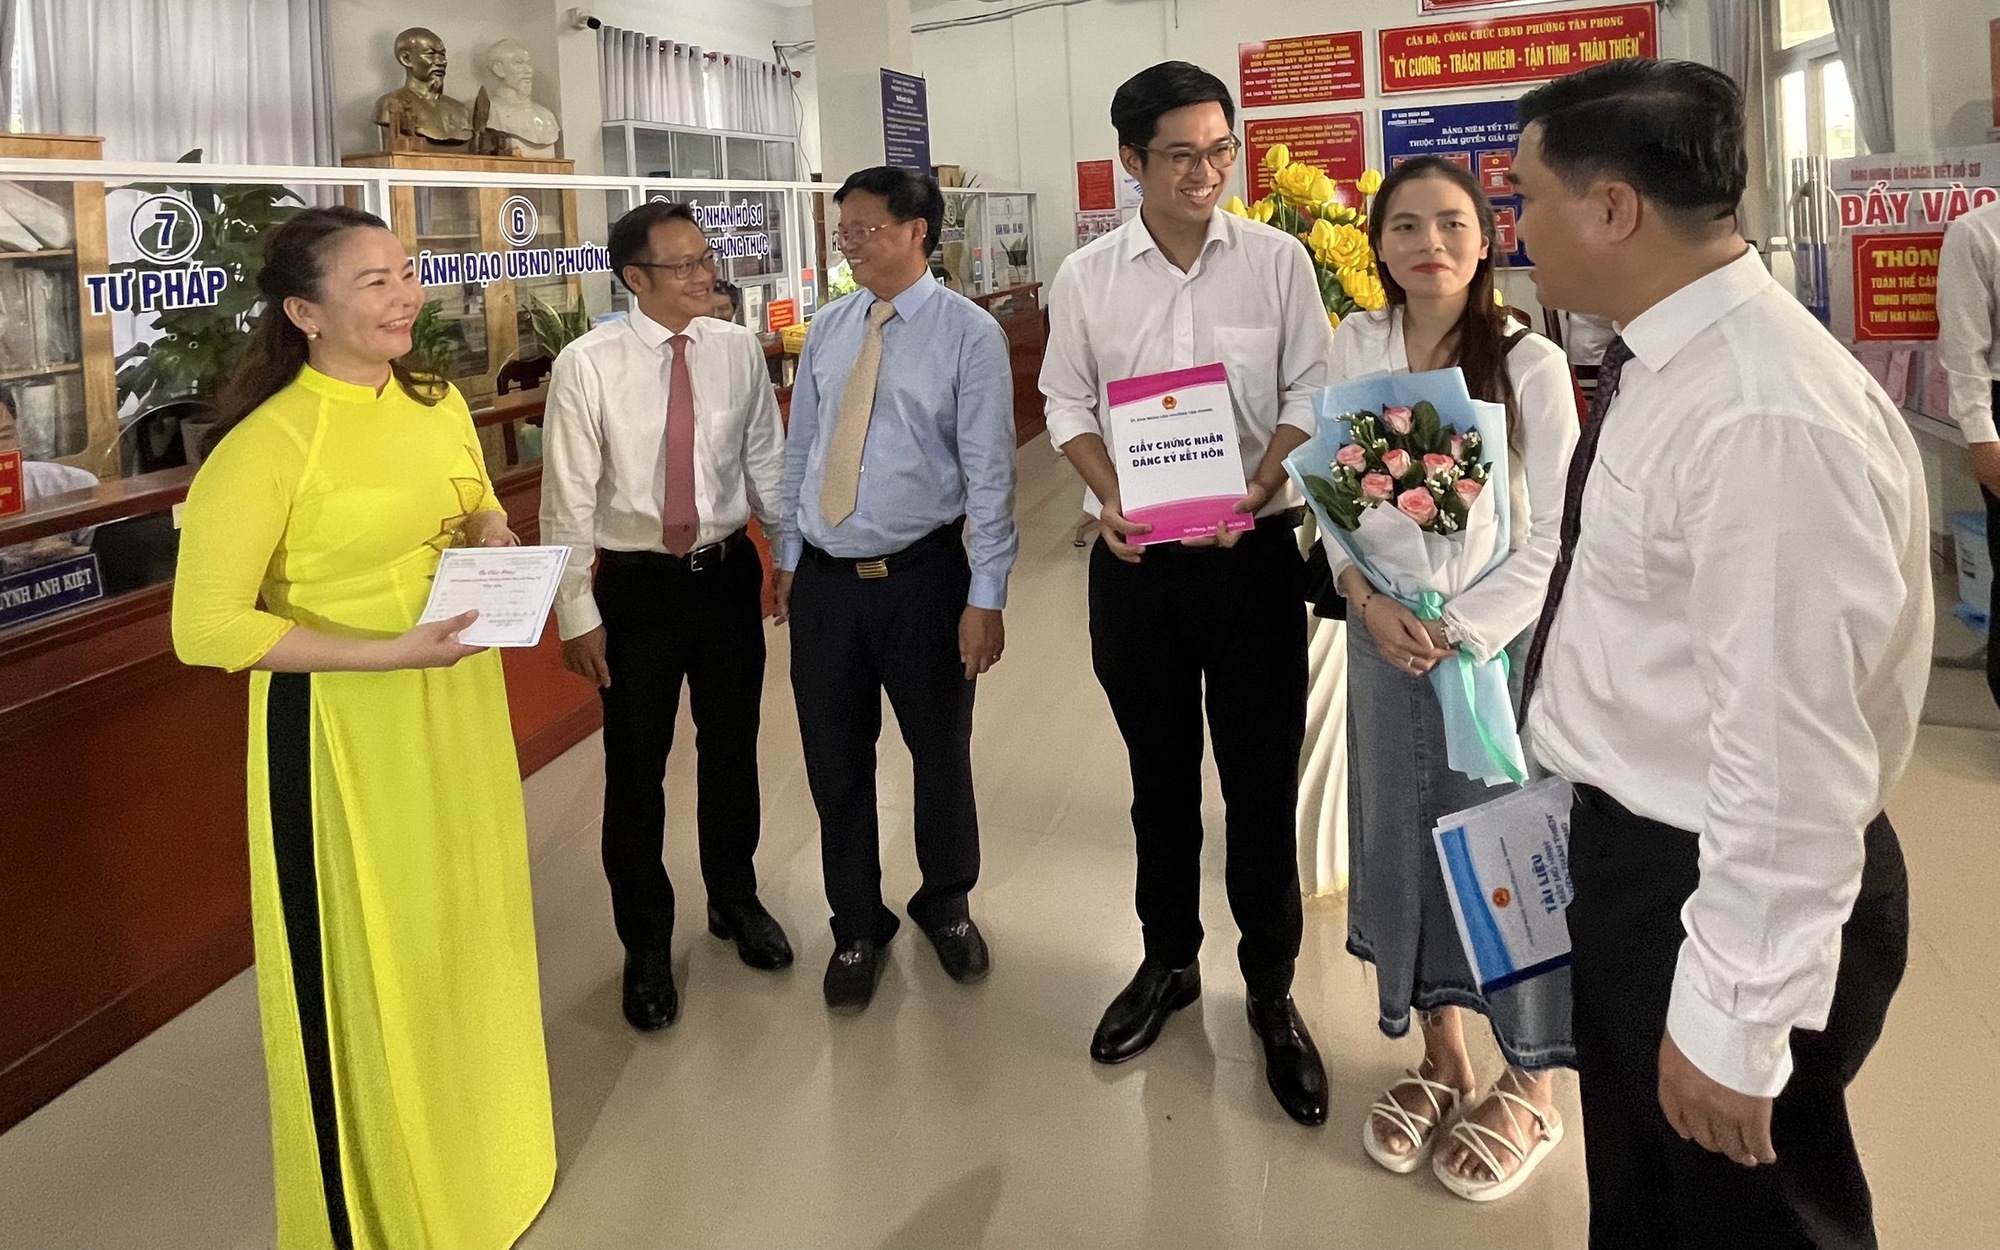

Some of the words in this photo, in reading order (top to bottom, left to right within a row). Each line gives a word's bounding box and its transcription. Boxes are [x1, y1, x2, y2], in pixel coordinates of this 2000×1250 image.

[1405, 35, 1424, 47] CÁN
[1443, 30, 1468, 42] CÔNG
[1470, 26, 1495, 40] CHỨC
[1497, 25, 1523, 38] UBND
[1526, 19, 1565, 35] PHƯỜNG
[1568, 18, 1587, 31] TÂN
[1589, 15, 1624, 28] PHONG
[1408, 55, 1441, 78] CƯƠNG
[1449, 49, 1481, 74] TRÁCH
[1483, 46, 1515, 74] NHIỆM
[1524, 46, 1545, 71] TẬN
[1547, 40, 1570, 65] TÌNH
[1579, 38, 1607, 62] THÂN
[704, 201, 735, 232] NHẬN
[735, 199, 750, 227] HỒ
[749, 203, 764, 227] SƠ
[1839, 181, 1912, 228] ĐẨY
[155, 211, 177, 249] 7
[511, 206, 526, 236] 6
[744, 233, 770, 260] THỰC
[1871, 246, 1939, 269] THÔN
[464, 250, 502, 288] ĐẠO
[506, 248, 552, 280] UBND
[1870, 274, 1896, 289] TOÀN
[1898, 272, 1916, 288] THỂ
[85, 268, 137, 317] TƯ
[139, 261, 228, 313] PHÁP
[1872, 294, 1899, 306] UBND
[1869, 310, 1888, 323] THỨ
[1890, 311, 1907, 322] HAI
[1908, 309, 1936, 322] HÀNG
[1129, 439, 1153, 454] GIẤY
[1155, 437, 1192, 451] CHỨNG
[1194, 433, 1224, 447] NHẬN
[1132, 453, 1161, 468] ĐĂNG
[1164, 449, 1177, 464] KÝ
[1179, 447, 1198, 462] KẾT
[1201, 447, 1224, 460] HÔN
[0, 584, 32, 611] ỲNH
[34, 577, 62, 600] ANH
[62, 566, 92, 592] KIỆT
[1531, 854, 1550, 886] LIỆU
[1540, 888, 1558, 915] TÀI
